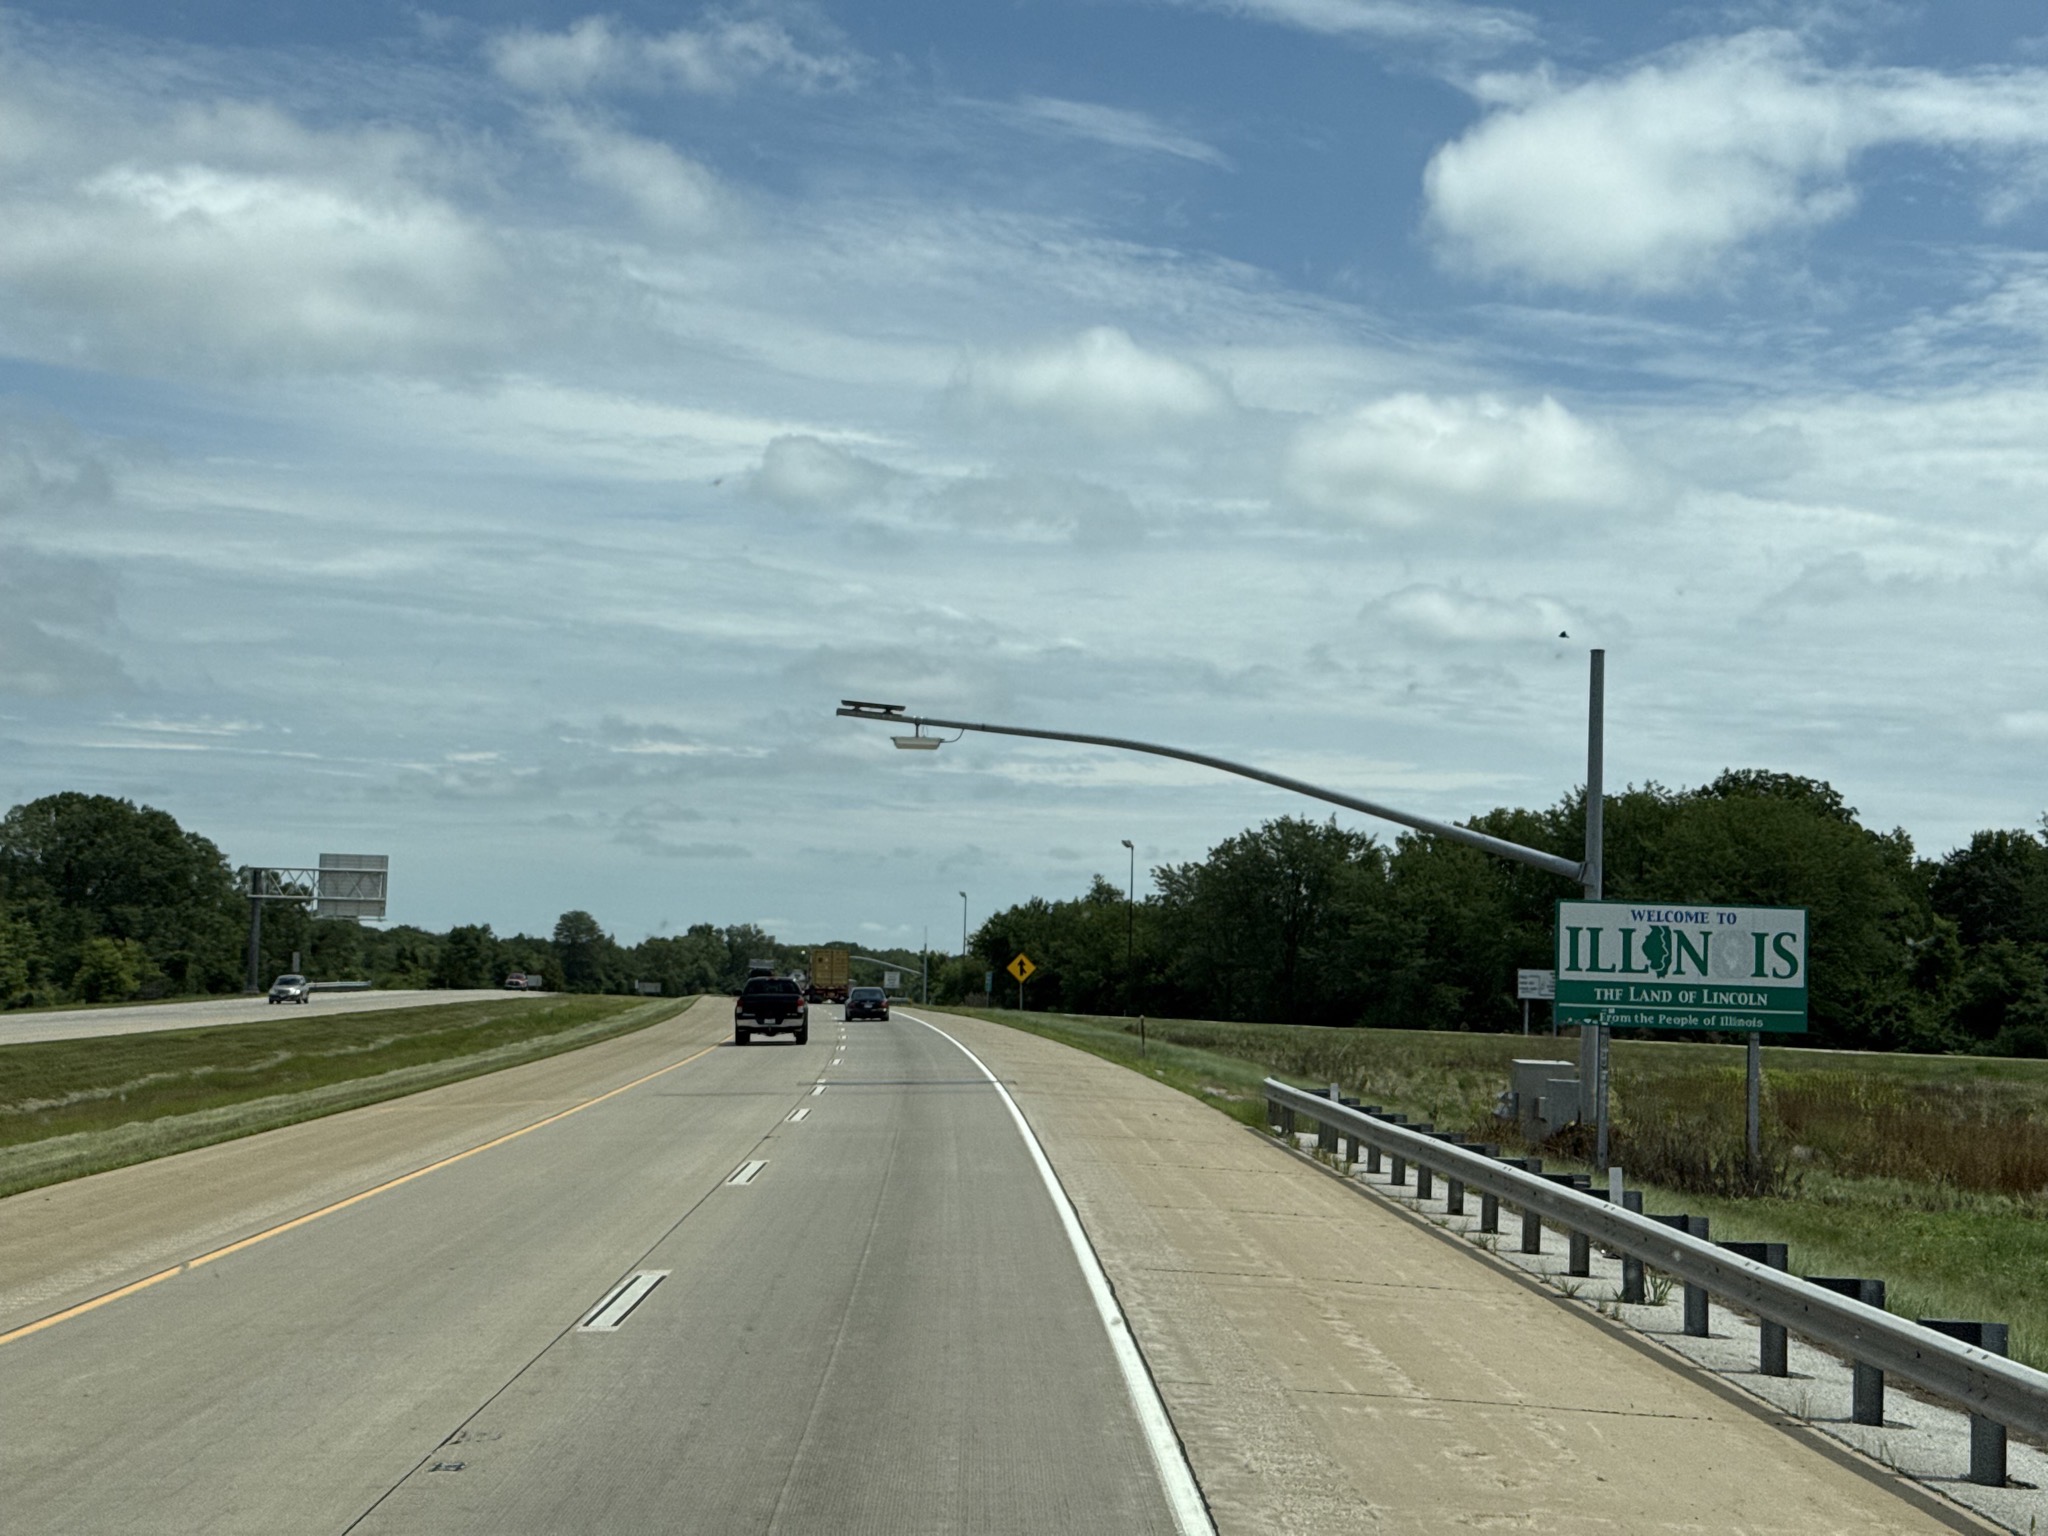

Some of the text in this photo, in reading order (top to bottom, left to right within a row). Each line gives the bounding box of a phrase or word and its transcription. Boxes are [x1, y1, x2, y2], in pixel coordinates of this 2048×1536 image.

[1631, 909, 1737, 925] WELCOME TO
[1593, 987, 1623, 1001] THE
[1678, 990, 1697, 1003] OF
[1599, 1012, 1764, 1028] From the People of Illinois
